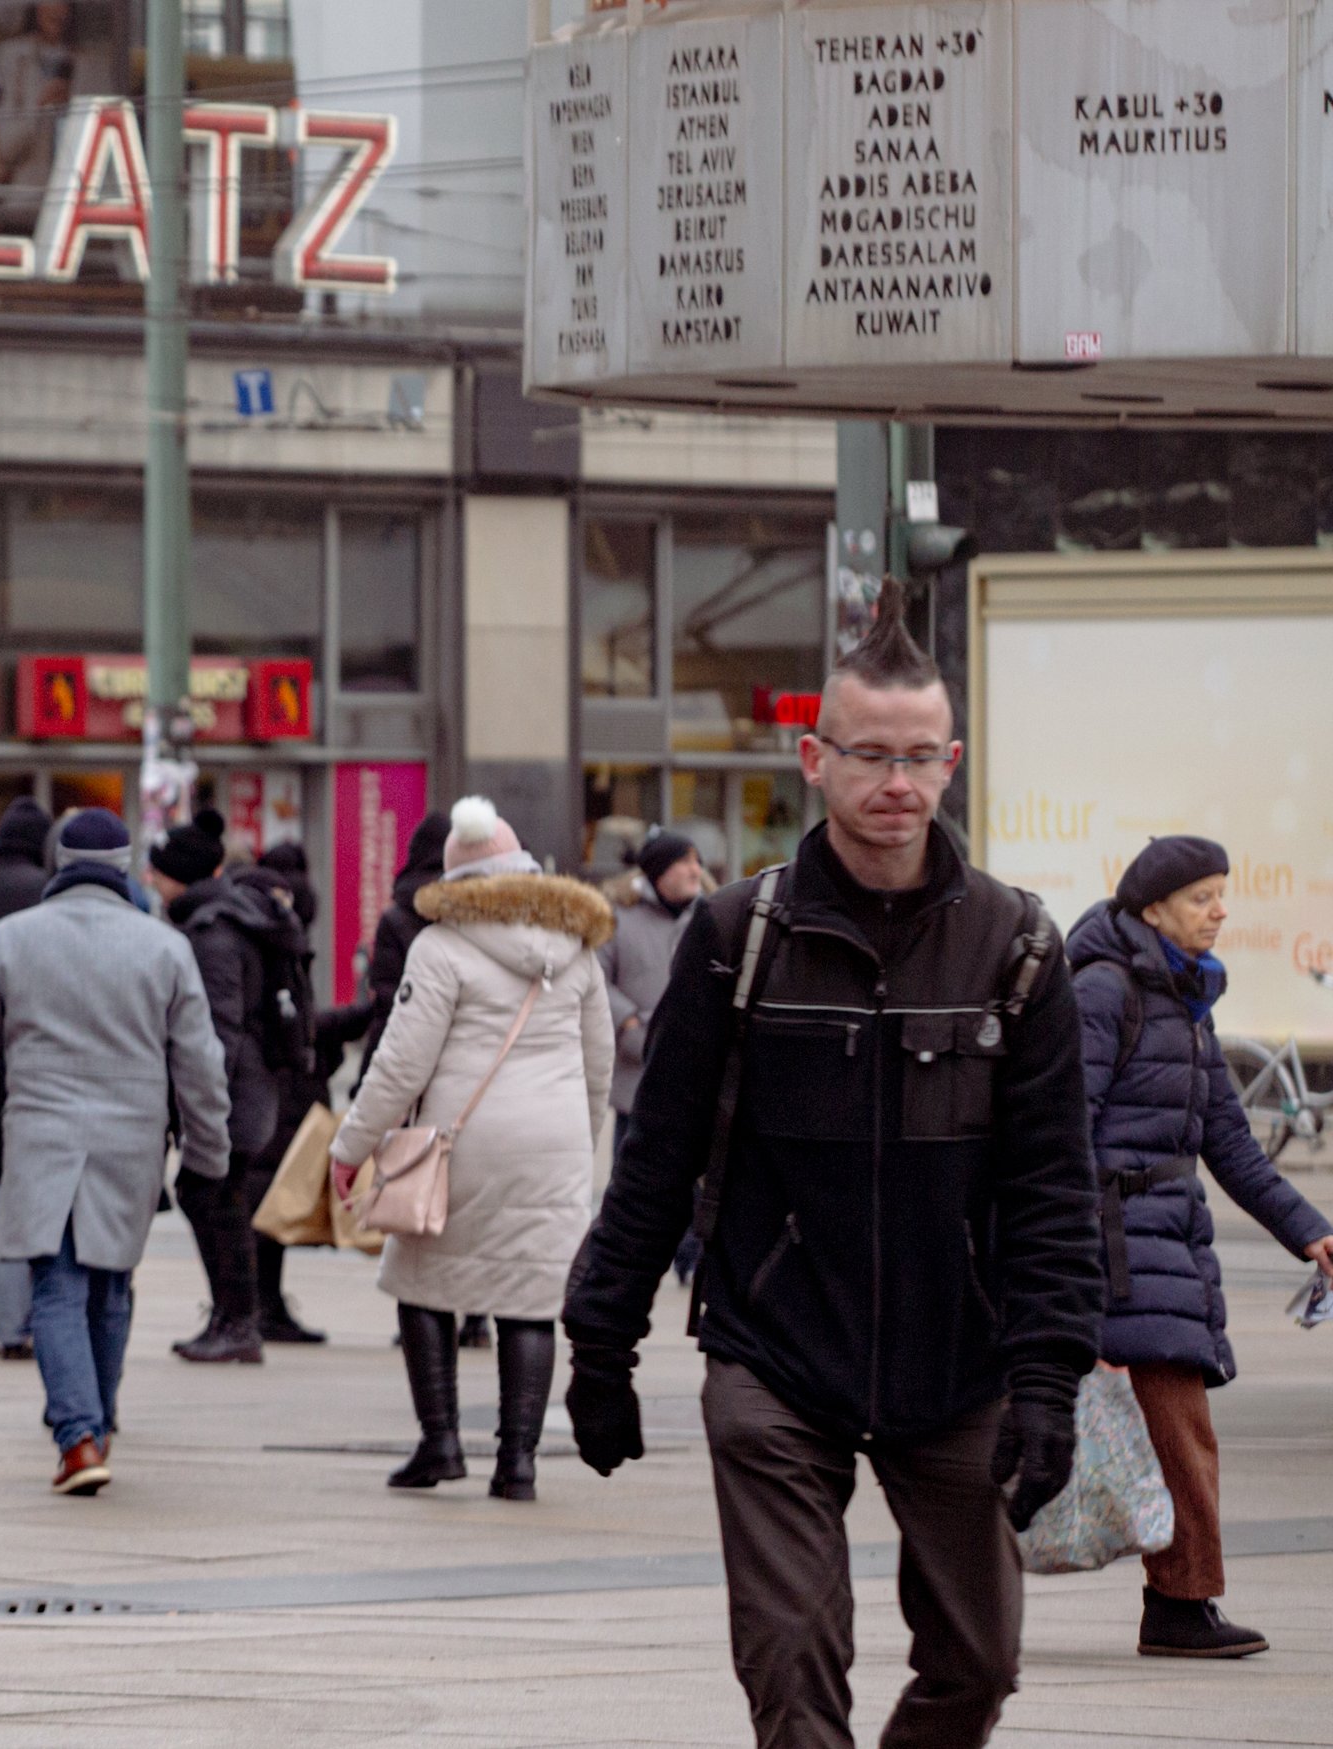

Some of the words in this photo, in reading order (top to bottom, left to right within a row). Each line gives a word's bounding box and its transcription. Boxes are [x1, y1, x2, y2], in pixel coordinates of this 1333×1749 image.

[668, 44, 740, 75] ANKARA
[815, 34, 924, 62] TEHERAN
[666, 79, 740, 109] ISTANBUL
[854, 66, 946, 95] BAGDAD
[868, 101, 931, 128] ADEN
[1075, 93, 1164, 121] KABUL
[1174, 91, 1223, 116] +30
[677, 112, 729, 141] ATHEN
[1079, 125, 1227, 155] MAURITIUS
[668, 151, 693, 177] TEL
[699, 147, 737, 174] AVIV
[855, 136, 941, 164] SANAA
[657, 179, 747, 210] JERUSALEM
[820, 172, 889, 199] ADDIS
[903, 169, 977, 196] ABEBA
[675, 216, 727, 243] BEIRUT
[820, 203, 976, 234] MOGADISCHU
[659, 248, 745, 278] DAMASKUS
[820, 238, 977, 269] DARESSALAM
[677, 284, 724, 310] KAIRO
[806, 272, 992, 305] ANTANANARIVO
[662, 315, 742, 346] KAPSTADT
[856, 308, 941, 337] KUWAIT
